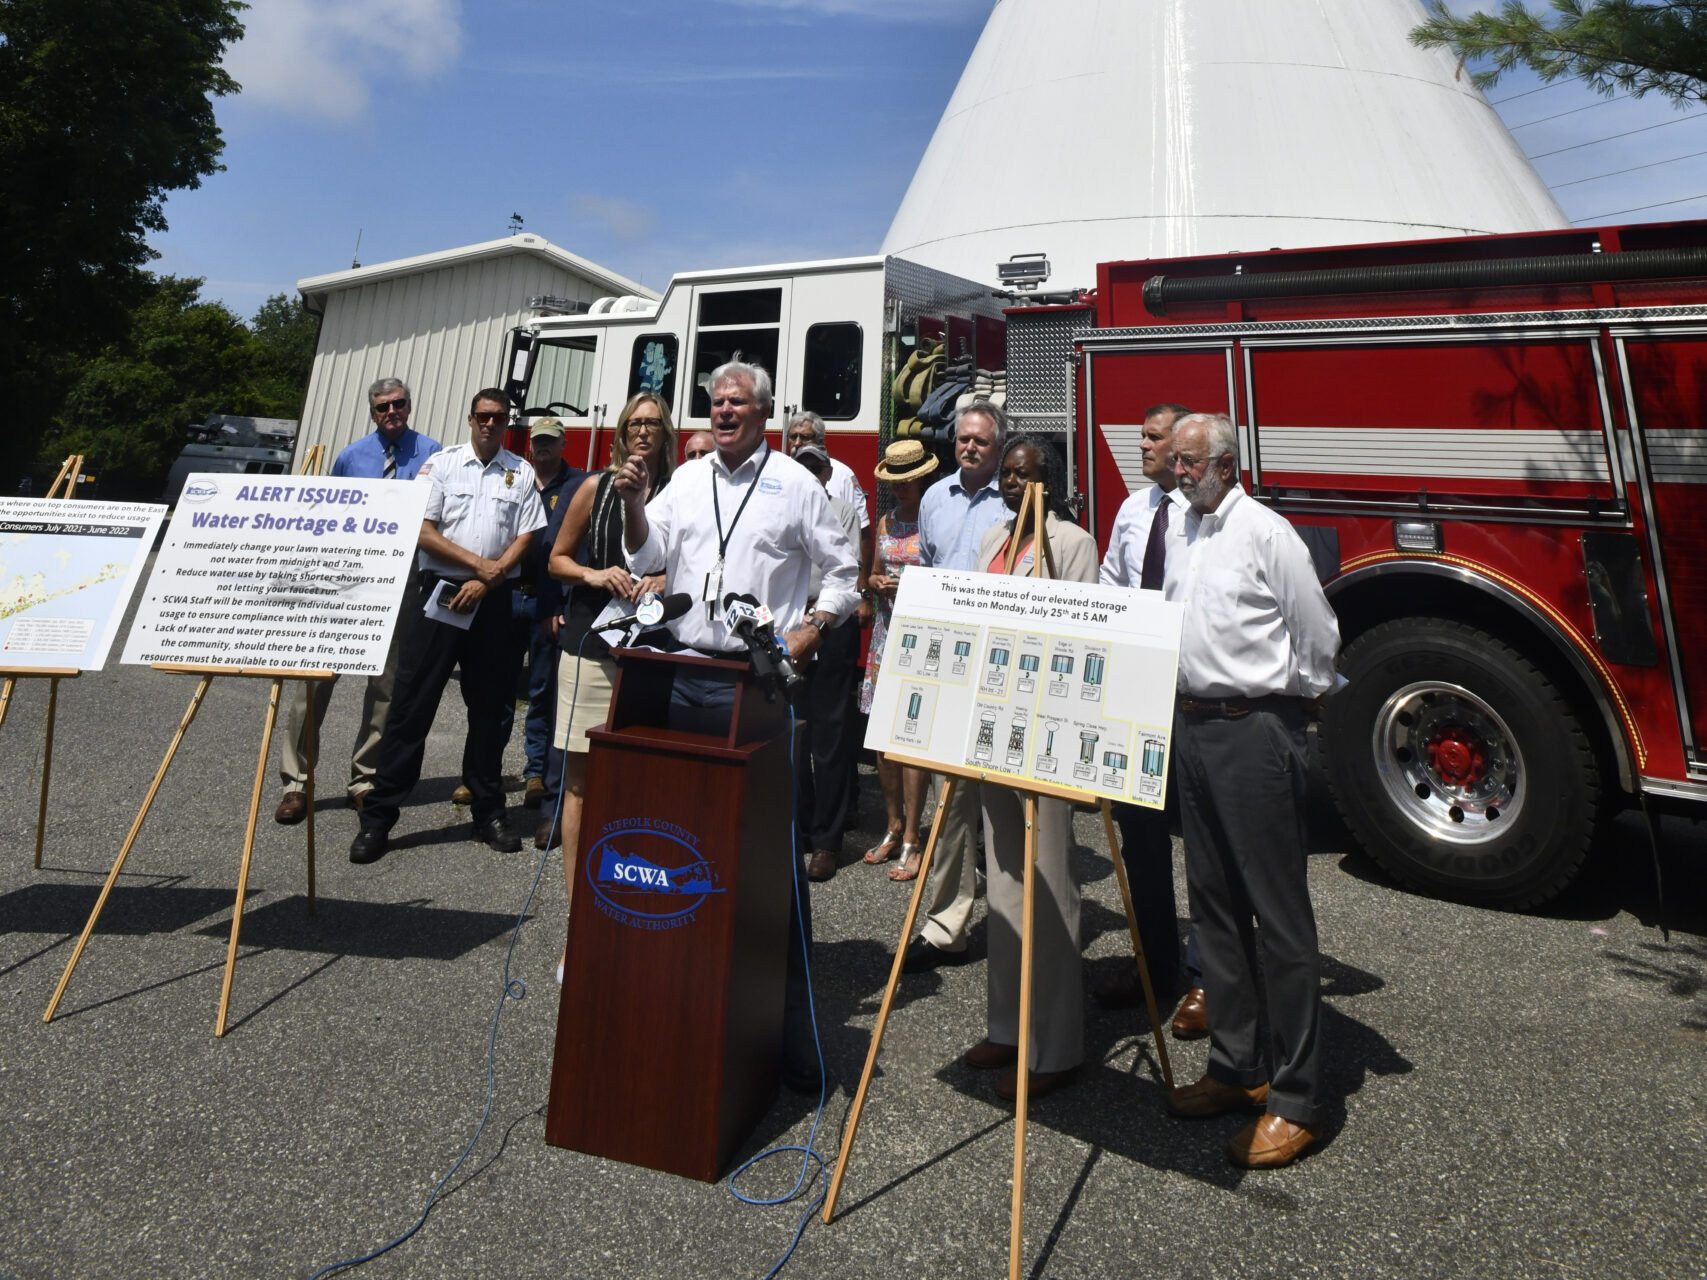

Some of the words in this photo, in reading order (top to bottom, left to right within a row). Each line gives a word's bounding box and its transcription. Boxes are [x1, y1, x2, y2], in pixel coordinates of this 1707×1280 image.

[236, 486, 295, 502] ALERT
[297, 487, 369, 505] ISSUED:
[0, 522, 43, 531] Consumers
[44, 524, 61, 533] July
[192, 512, 249, 528] Water
[252, 513, 338, 536] Shortage
[342, 517, 357, 533] &
[363, 518, 398, 534] Use
[184, 542, 238, 552] Immediately
[240, 543, 272, 553] change
[296, 544, 318, 552] lawn
[321, 547, 362, 557] watering
[364, 548, 386, 556] time.
[256, 556, 277, 564] from
[280, 558, 321, 568] midnight
[322, 559, 340, 567] and
[343, 560, 363, 568] 7am.
[176, 568, 207, 576] Reduce
[210, 570, 236, 578] water
[255, 570, 267, 580] by
[268, 570, 297, 582] taking
[299, 572, 335, 581] shorter
[336, 573, 375, 583] showers
[377, 576, 395, 584] and
[234, 584, 264, 595] letting
[266, 586, 287, 595] your
[289, 585, 318, 595] faucet
[320, 588, 339, 596] run.
[942, 583, 956, 592] This
[977, 587, 990, 596] the
[993, 590, 1017, 599] status
[1020, 592, 1030, 600] of
[1049, 595, 1088, 607] elevated
[1091, 601, 1127, 613] storage
[163, 595, 188, 604] SCWA
[190, 596, 212, 604] Staff
[214, 597, 230, 605] will
[232, 597, 242, 606] be
[245, 598, 296, 610] monitoring
[298, 599, 344, 609] individual
[346, 604, 391, 612] customer
[954, 598, 974, 607] tanks
[990, 601, 1026, 615] Monday,
[1030, 606, 1048, 618] July
[1051, 608, 1069, 617] 25th
[1071, 612, 1080, 620] at
[1083, 612, 1088, 620] 5
[1091, 613, 1108, 623] AM
[160, 611, 185, 620] usage
[232, 613, 284, 623] compliance
[286, 614, 307, 622] with
[310, 615, 328, 624] this
[330, 617, 358, 625] water
[360, 618, 384, 626] alert.
[155, 624, 175, 632] Lack
[178, 624, 188, 632] of
[217, 626, 235, 634] and
[265, 630, 306, 638] pressure
[309, 630, 316, 638] is
[319, 630, 368, 642] dangerous
[161, 638, 176, 646] the
[178, 640, 230, 651] community,
[234, 641, 266, 650] should
[268, 642, 293, 652] there
[295, 644, 306, 652] be
[317, 645, 335, 655] fire,
[339, 646, 366, 655] those
[140, 654, 184, 662] resources
[211, 655, 222, 664] be
[224, 656, 267, 666] available
[269, 658, 279, 666] to
[300, 659, 320, 668] first
[322, 662, 378, 672] responders.
[982, 761, 999, 771] Shore
[999, 765, 1011, 773] Low
[602, 817, 651, 833] SUFFOLK
[654, 819, 700, 845] COUNTY
[613, 863, 669, 887] SCWA
[594, 896, 627, 924] WATER
[629, 911, 697, 930] AUTHORITY
